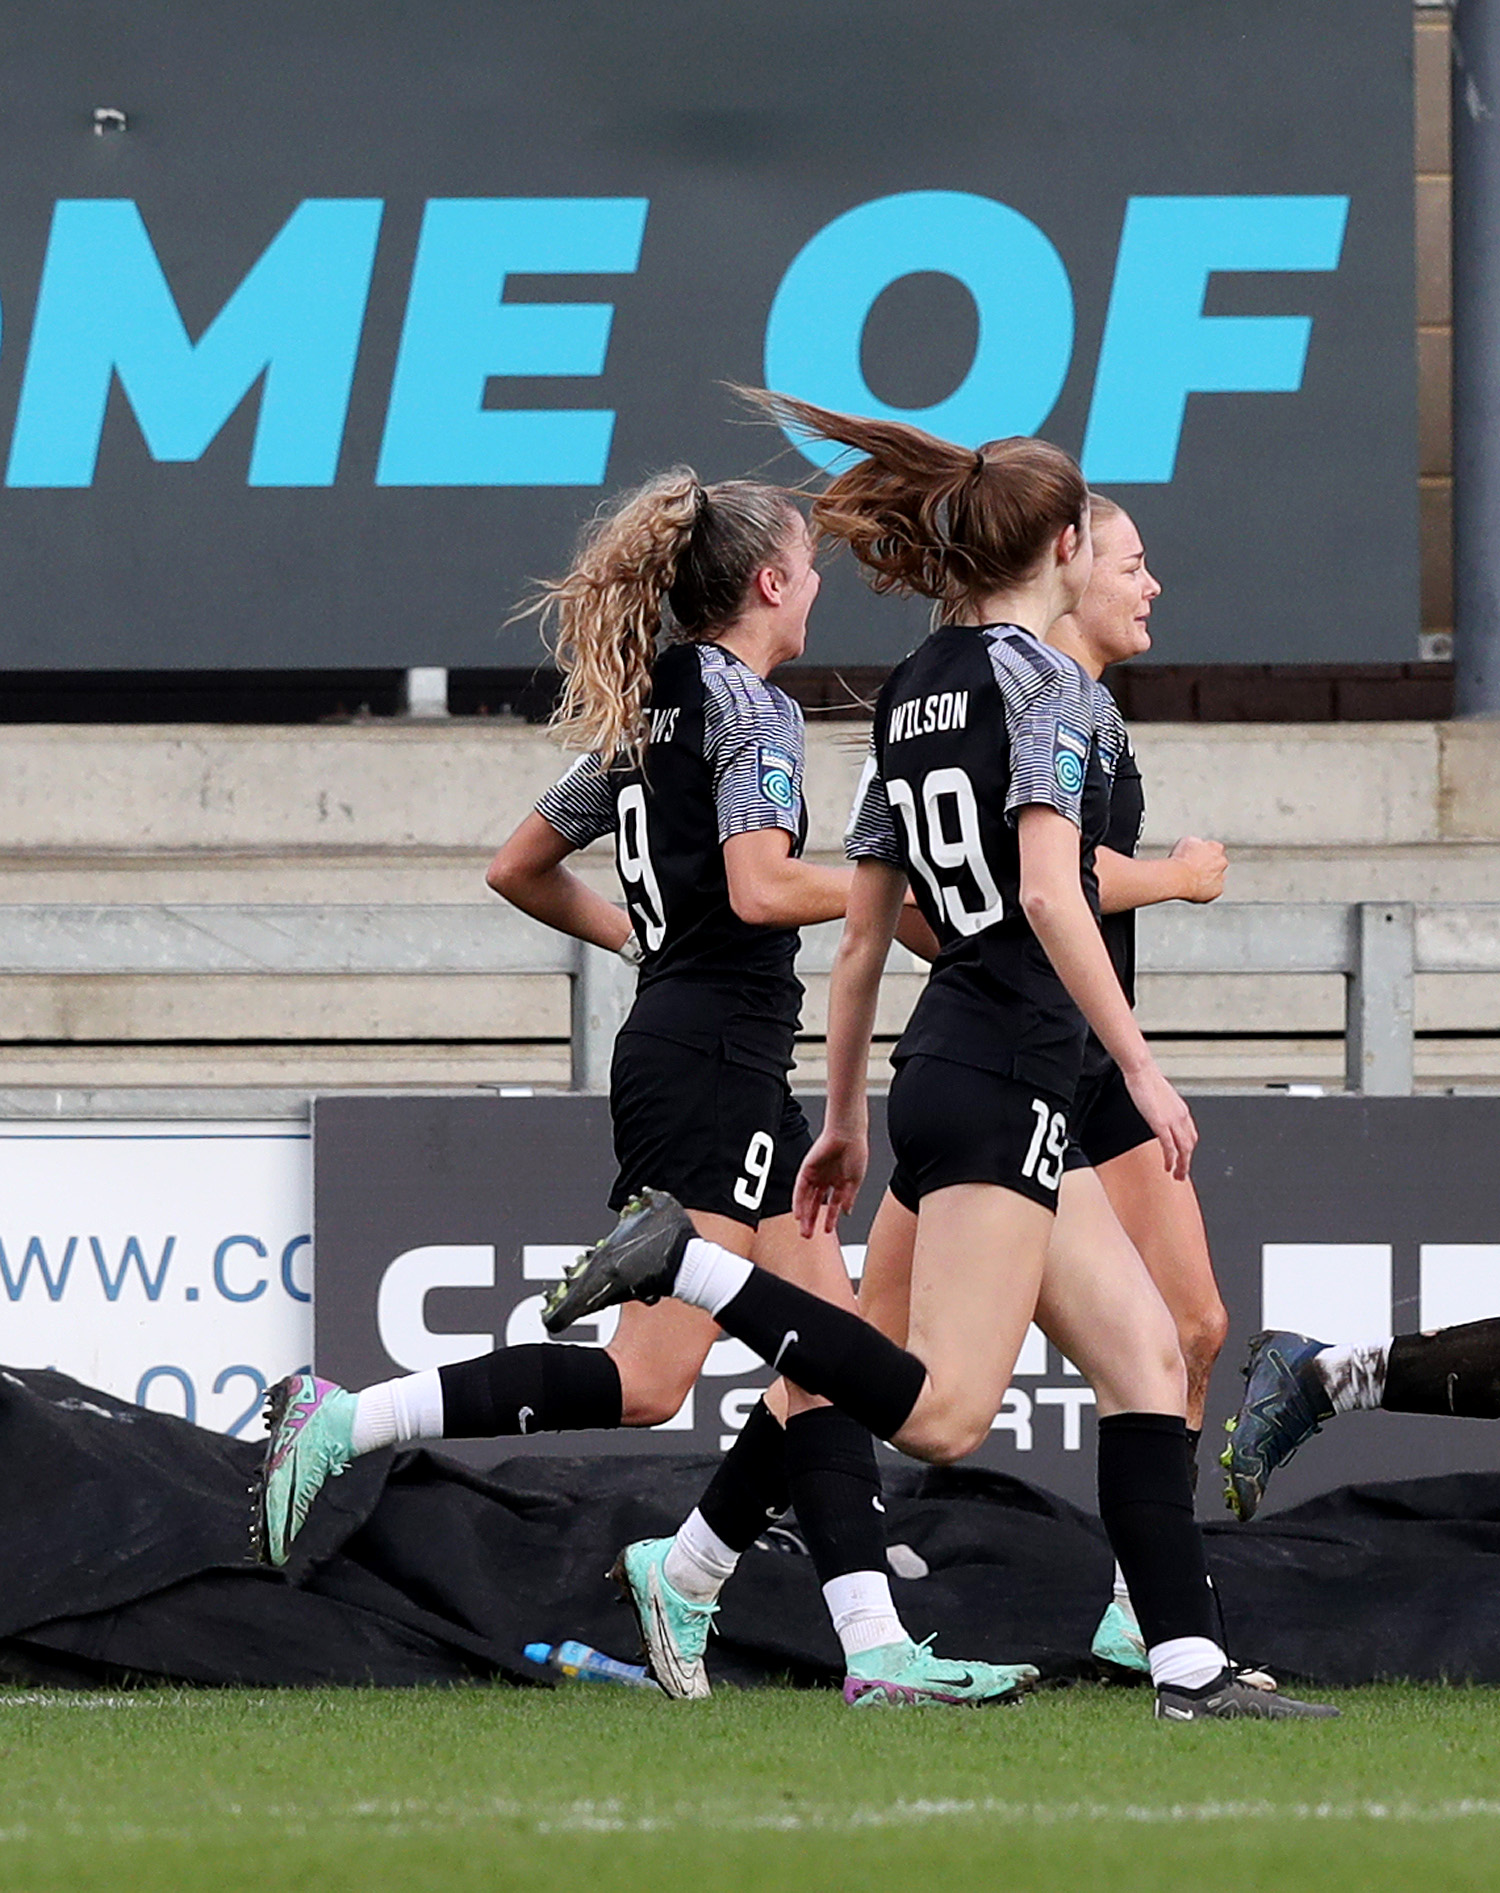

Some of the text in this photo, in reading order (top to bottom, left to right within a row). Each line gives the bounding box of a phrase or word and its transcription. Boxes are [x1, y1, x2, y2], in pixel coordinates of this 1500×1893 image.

[0, 197, 650, 488] ME
[764, 190, 1351, 484] OF
[888, 690, 969, 744] WILSON
[616, 783, 667, 952] 9
[885, 767, 1004, 937] 19
[733, 1131, 774, 1210] 9
[1021, 1098, 1069, 1191] 19
